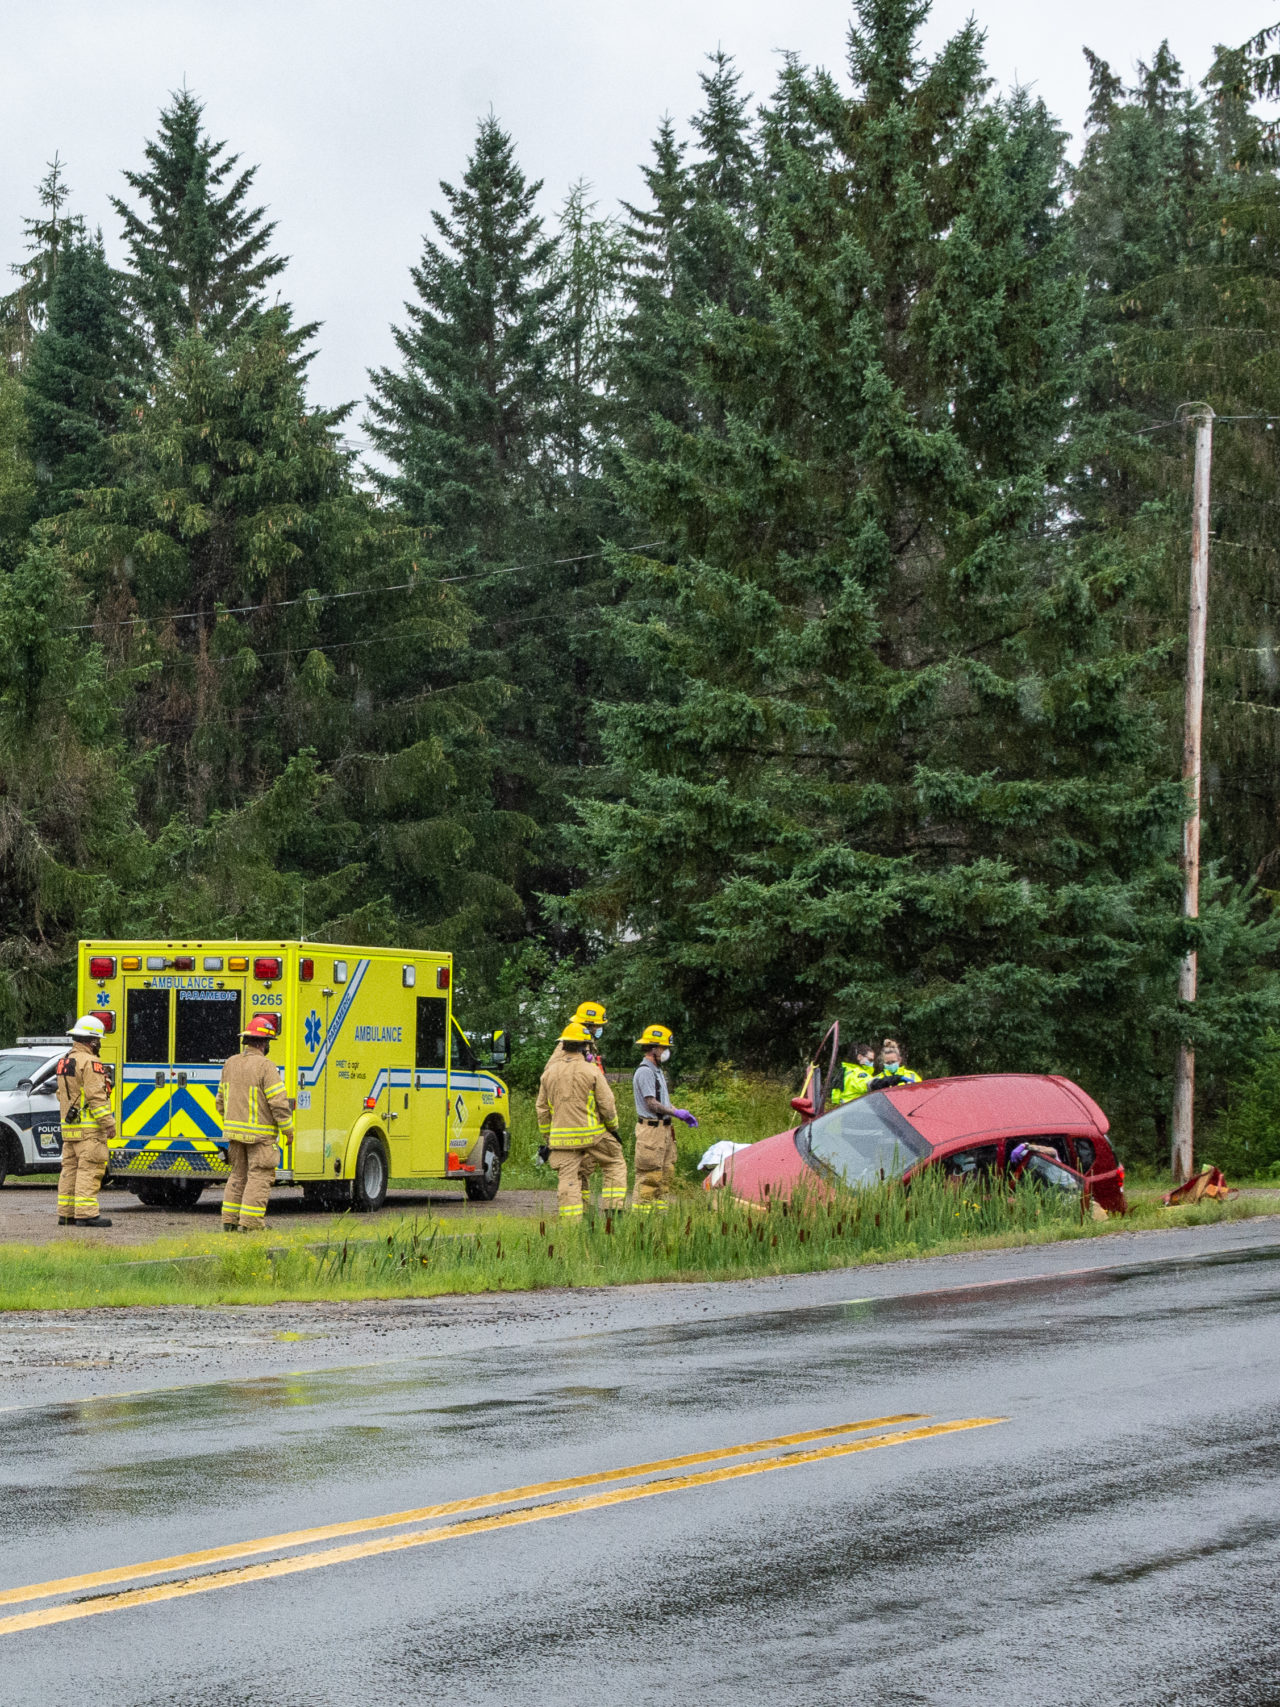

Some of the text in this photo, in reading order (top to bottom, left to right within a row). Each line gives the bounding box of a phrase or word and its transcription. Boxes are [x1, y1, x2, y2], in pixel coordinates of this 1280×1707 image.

[151, 977, 214, 988] AMBULANCE
[180, 991, 237, 1001] PARAMEDIC
[251, 994, 282, 1005] 9265
[355, 1026, 403, 1042] AMBULANCE
